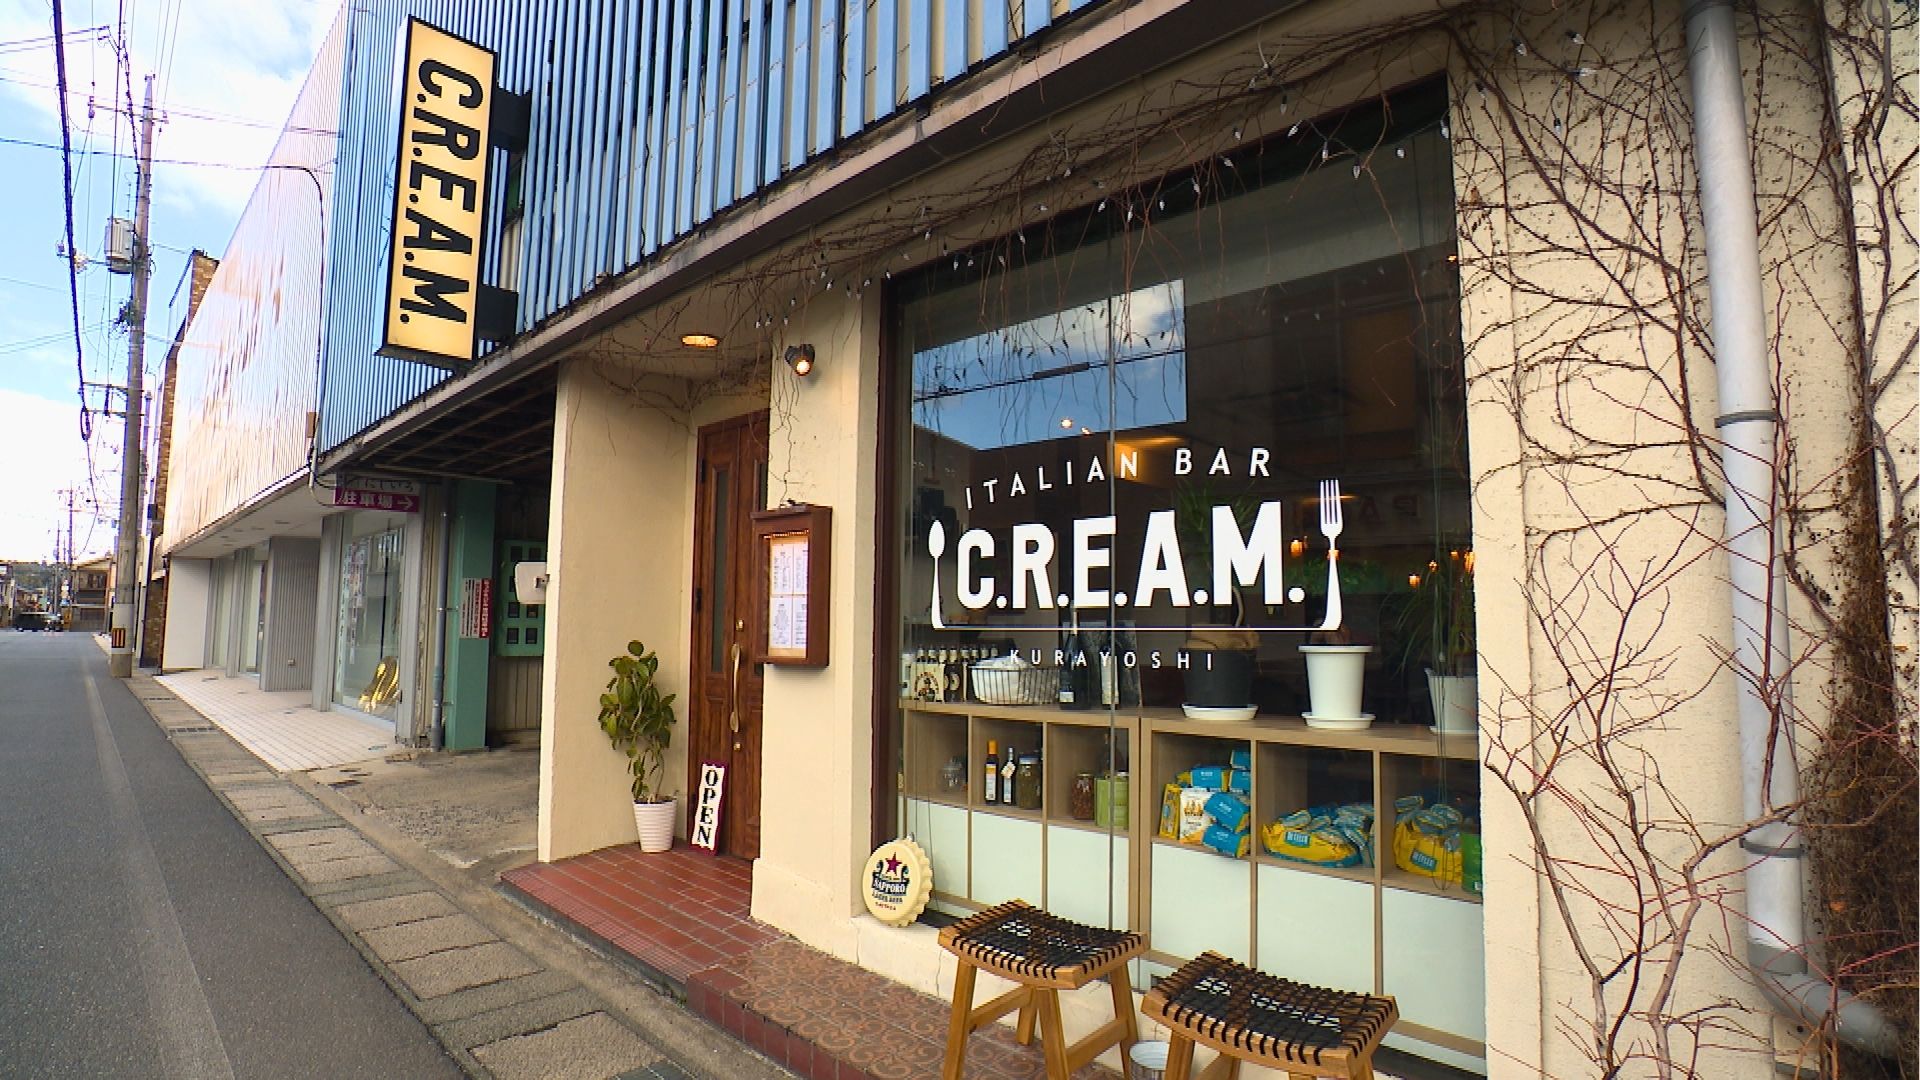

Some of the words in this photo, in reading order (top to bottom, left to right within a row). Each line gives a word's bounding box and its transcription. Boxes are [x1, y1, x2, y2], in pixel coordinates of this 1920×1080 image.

[400, 57, 485, 325] C.R.E.A.M.
[336, 489, 393, 509] 駐車場
[966, 451, 1139, 510] ITALIAN
[1174, 447, 1271, 478] BAR
[956, 500, 1306, 610] C.R.E.A.M.
[1009, 647, 1214, 671] KURAYOSHI
[697, 769, 720, 845] OPEN
[873, 878, 906, 893] SAPPORO
